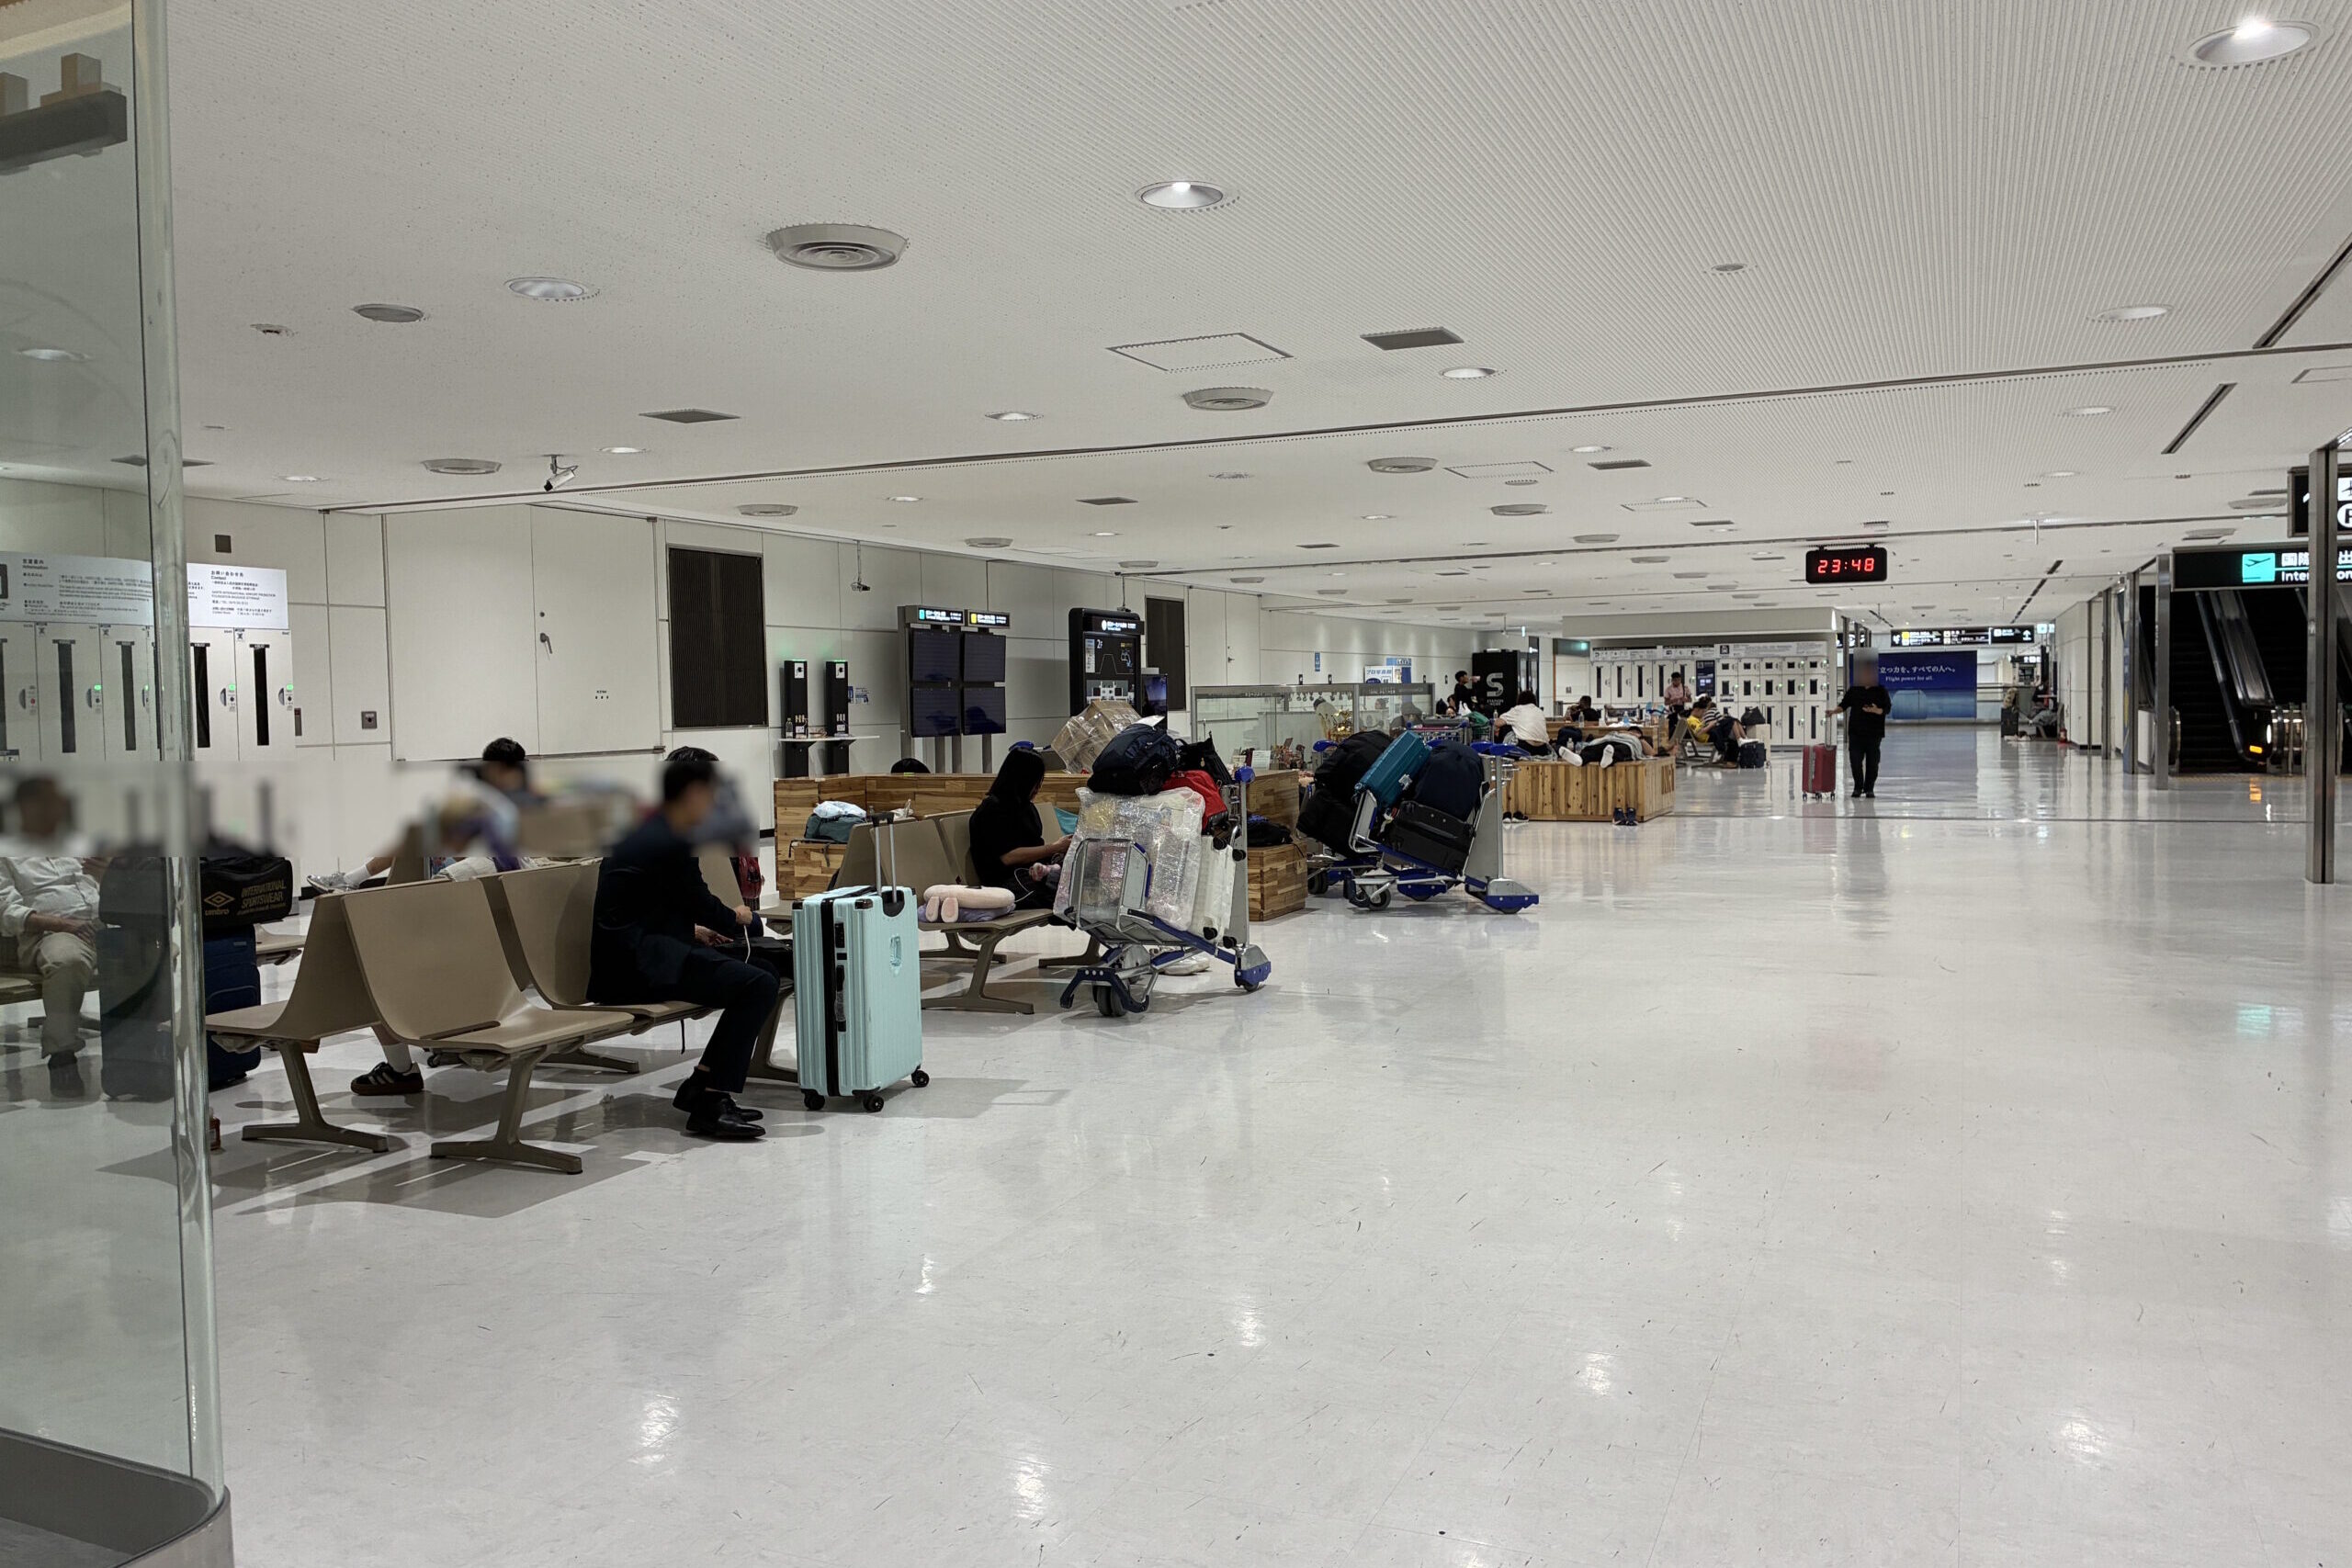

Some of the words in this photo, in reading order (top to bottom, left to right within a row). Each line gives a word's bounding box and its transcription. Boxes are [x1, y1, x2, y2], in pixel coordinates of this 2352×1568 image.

[1817, 558, 1875, 574] 23:48
[1486, 672, 1504, 697] S
[241, 879, 287, 898] INTERNATIONAL
[241, 891, 284, 909] SPORTSWEAR
[205, 908, 230, 917] umbro
